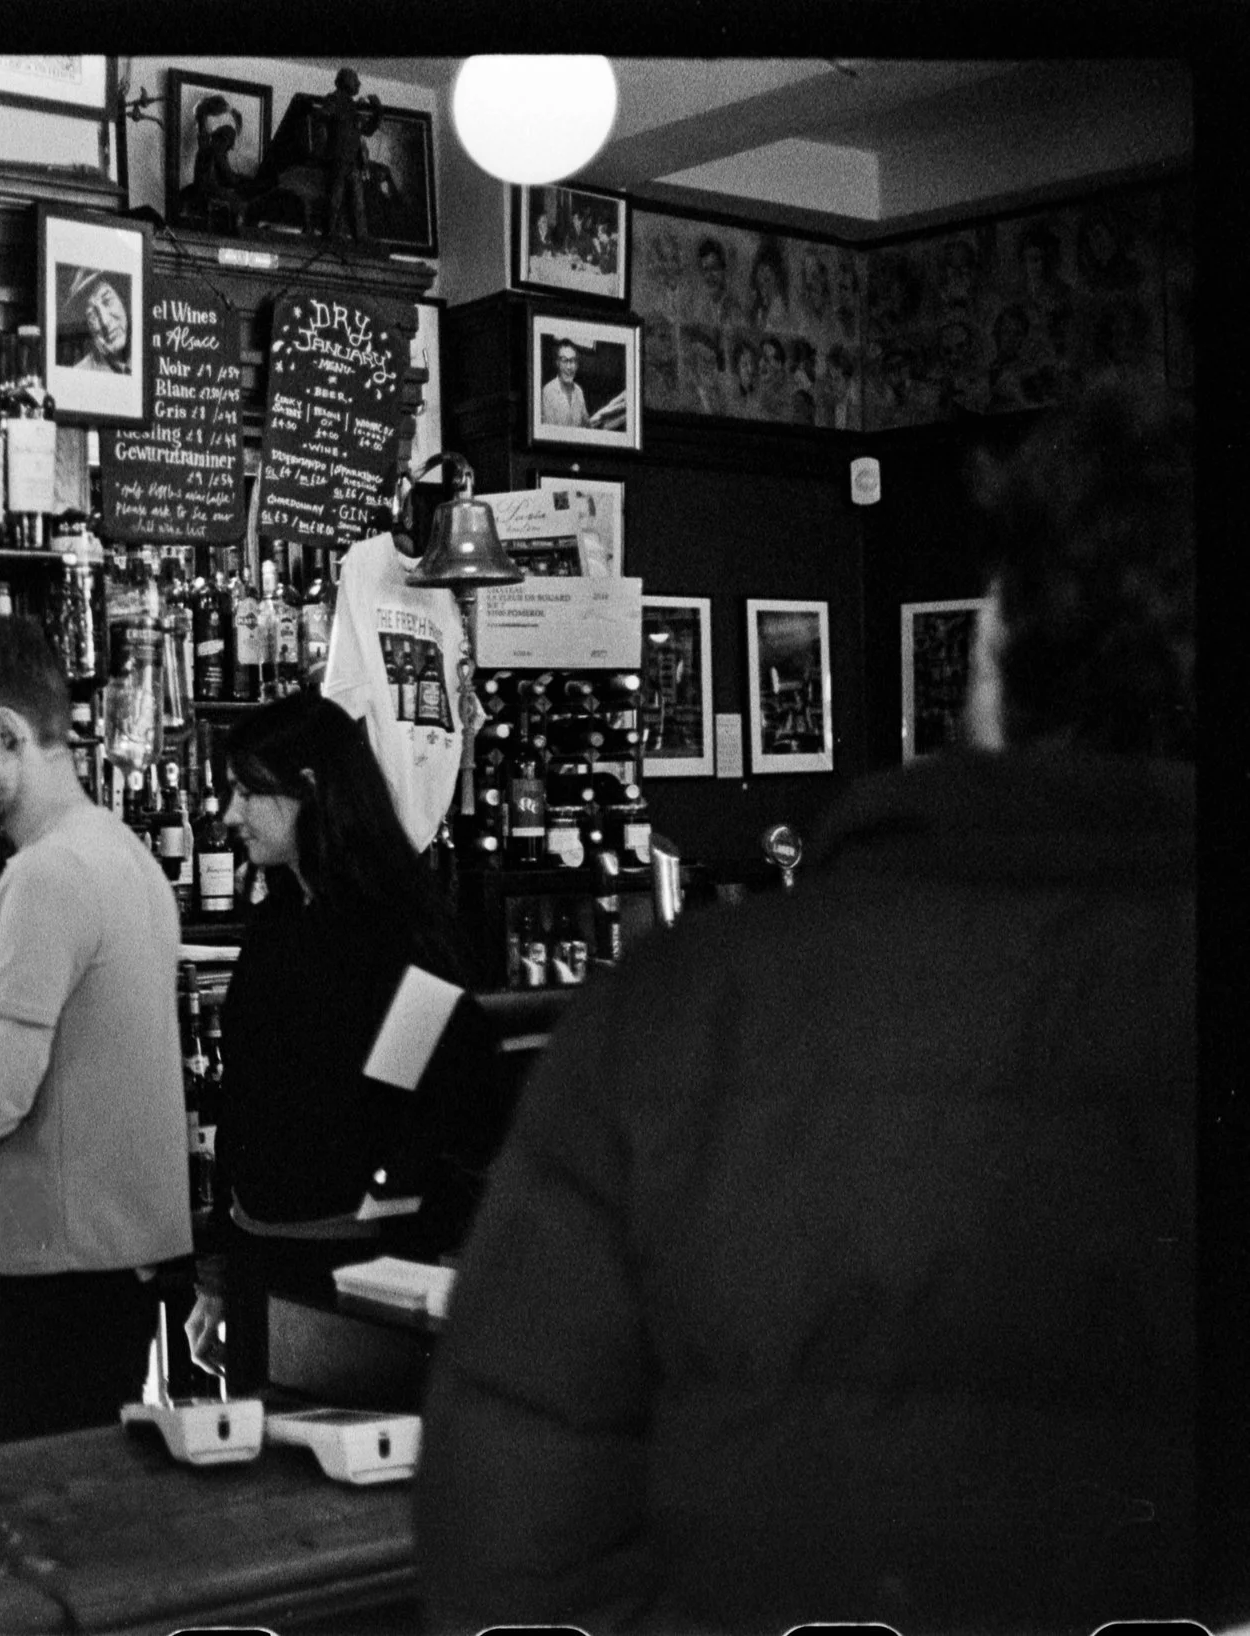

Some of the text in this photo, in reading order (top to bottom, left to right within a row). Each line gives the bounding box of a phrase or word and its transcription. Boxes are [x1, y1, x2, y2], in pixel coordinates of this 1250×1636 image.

[170, 300, 218, 325] Wines
[309, 299, 372, 347] DRY
[165, 325, 220, 353] Alsace
[293, 326, 397, 384] JANUARY
[159, 356, 191, 377] Noir
[155, 378, 197, 399] Blanc
[154, 400, 187, 419] Gris
[308, 442, 339, 457] WINE
[339, 504, 368, 524] GIN
[377, 608, 393, 628] THE
